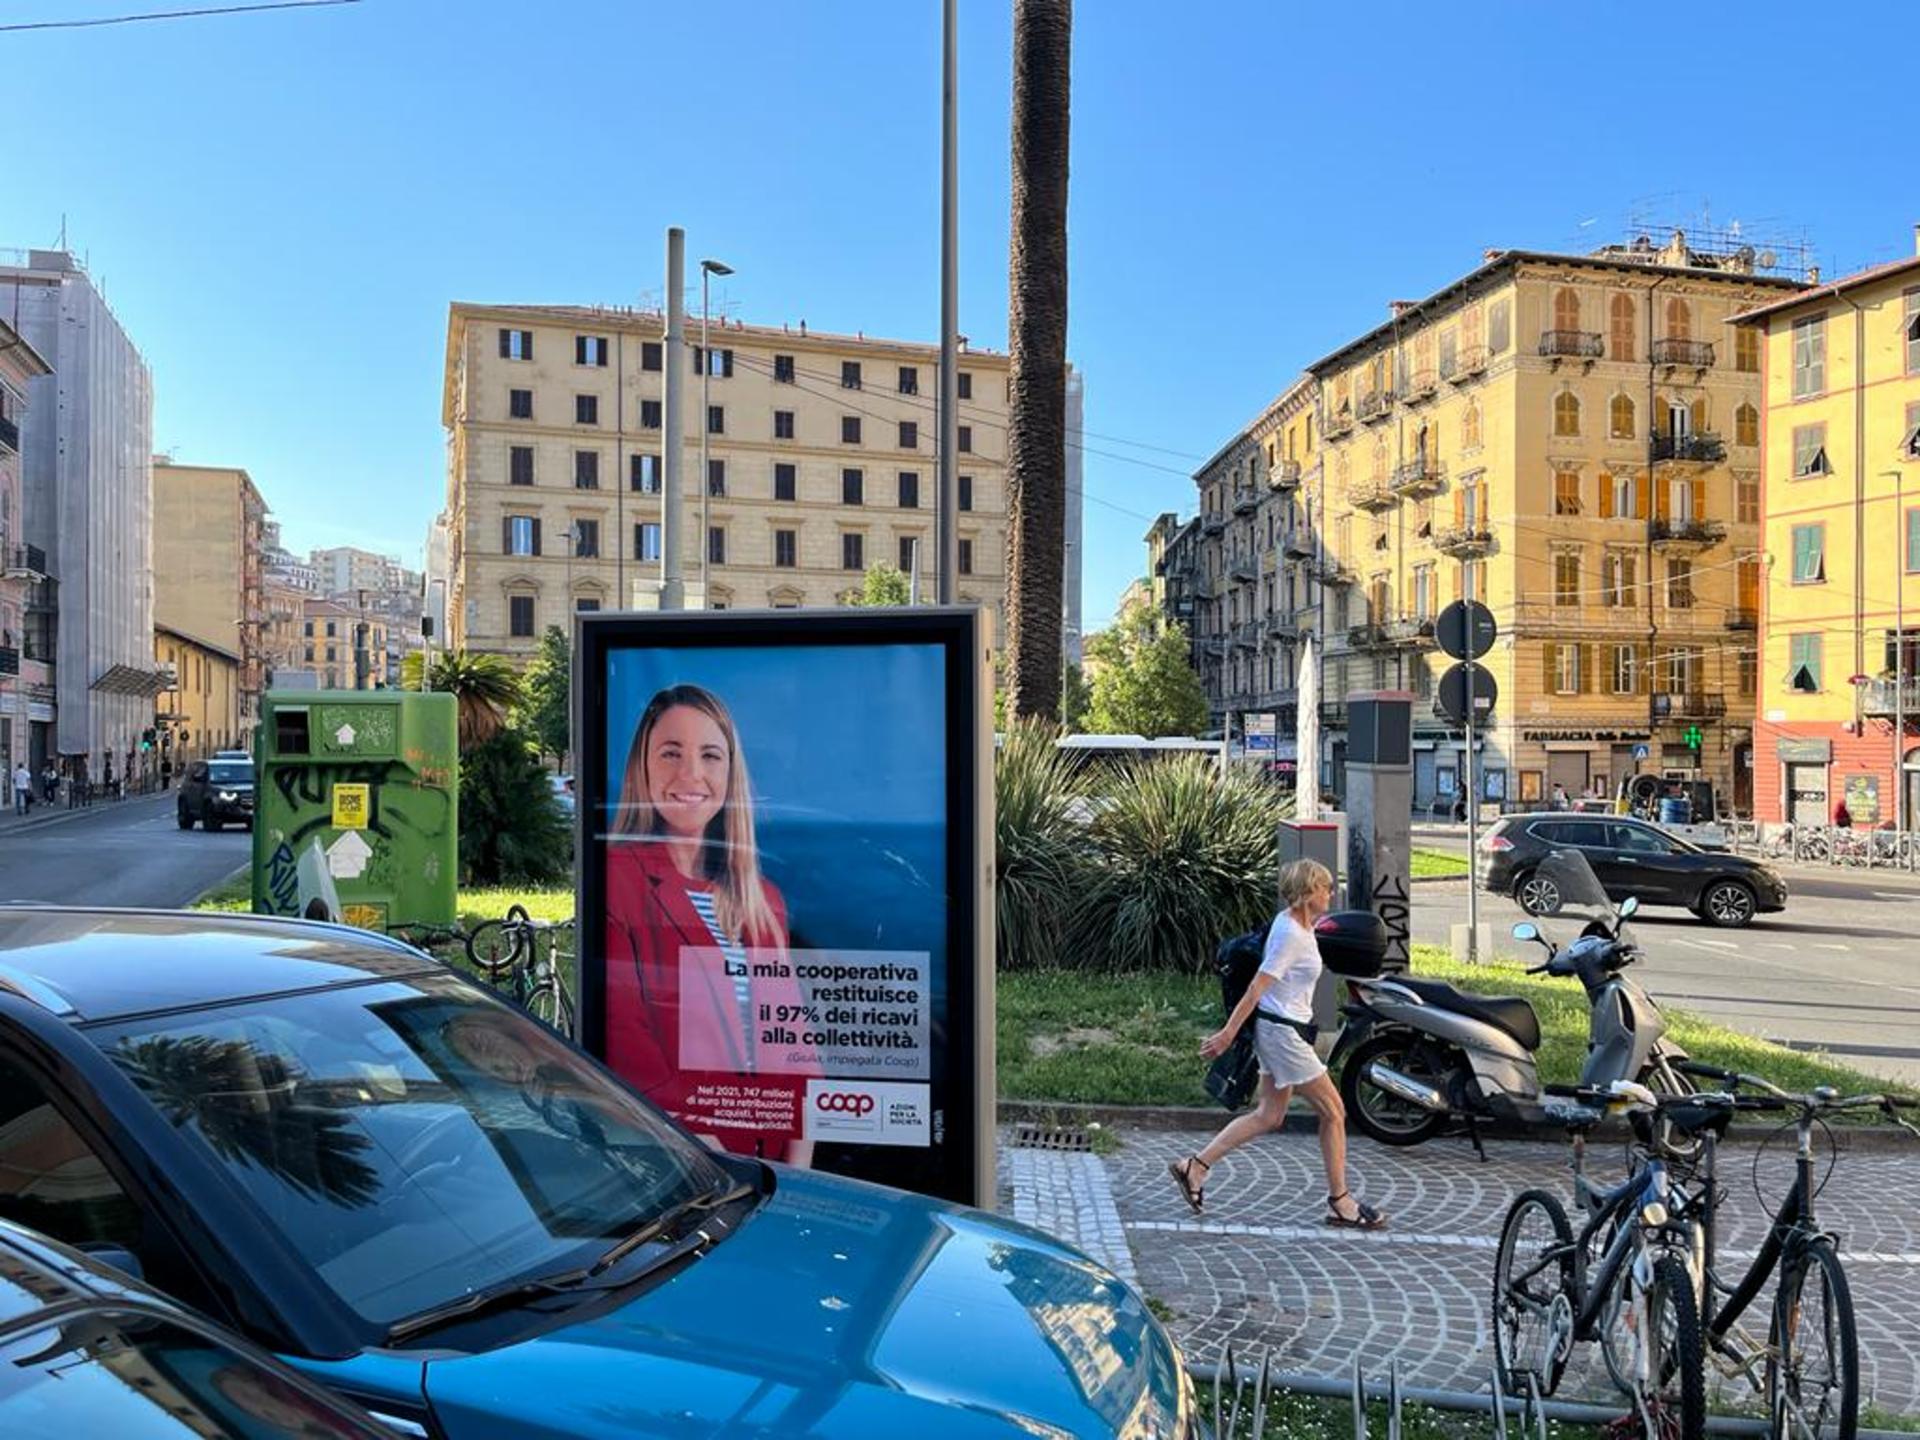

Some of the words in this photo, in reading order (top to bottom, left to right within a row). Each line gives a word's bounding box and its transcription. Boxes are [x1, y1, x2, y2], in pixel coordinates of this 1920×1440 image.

[1523, 730, 1593, 742] FARMACIA
[725, 960, 747, 976] La
[753, 961, 790, 978] mia
[796, 963, 918, 982] cooperativa
[812, 985, 918, 1003] restituisce
[760, 1005, 770, 1021] il
[776, 1005, 819, 1023] 97%
[825, 1007, 856, 1024] dei
[862, 1008, 918, 1026] ricavi
[762, 1027, 797, 1045] alla
[802, 1029, 918, 1049] collettività.
[827, 1054, 882, 1067] impiegata
[885, 1055, 919, 1068] Coop)
[697, 1085, 714, 1095] Nel
[743, 1087, 760, 1097] 747
[762, 1088, 795, 1099] milioni
[686, 1095, 696, 1105] di
[697, 1097, 720, 1107] euro
[721, 1097, 735, 1107] tra
[816, 1093, 875, 1117] coop
[889, 1103, 917, 1111] AZIONI
[755, 1109, 794, 1120] imposte
